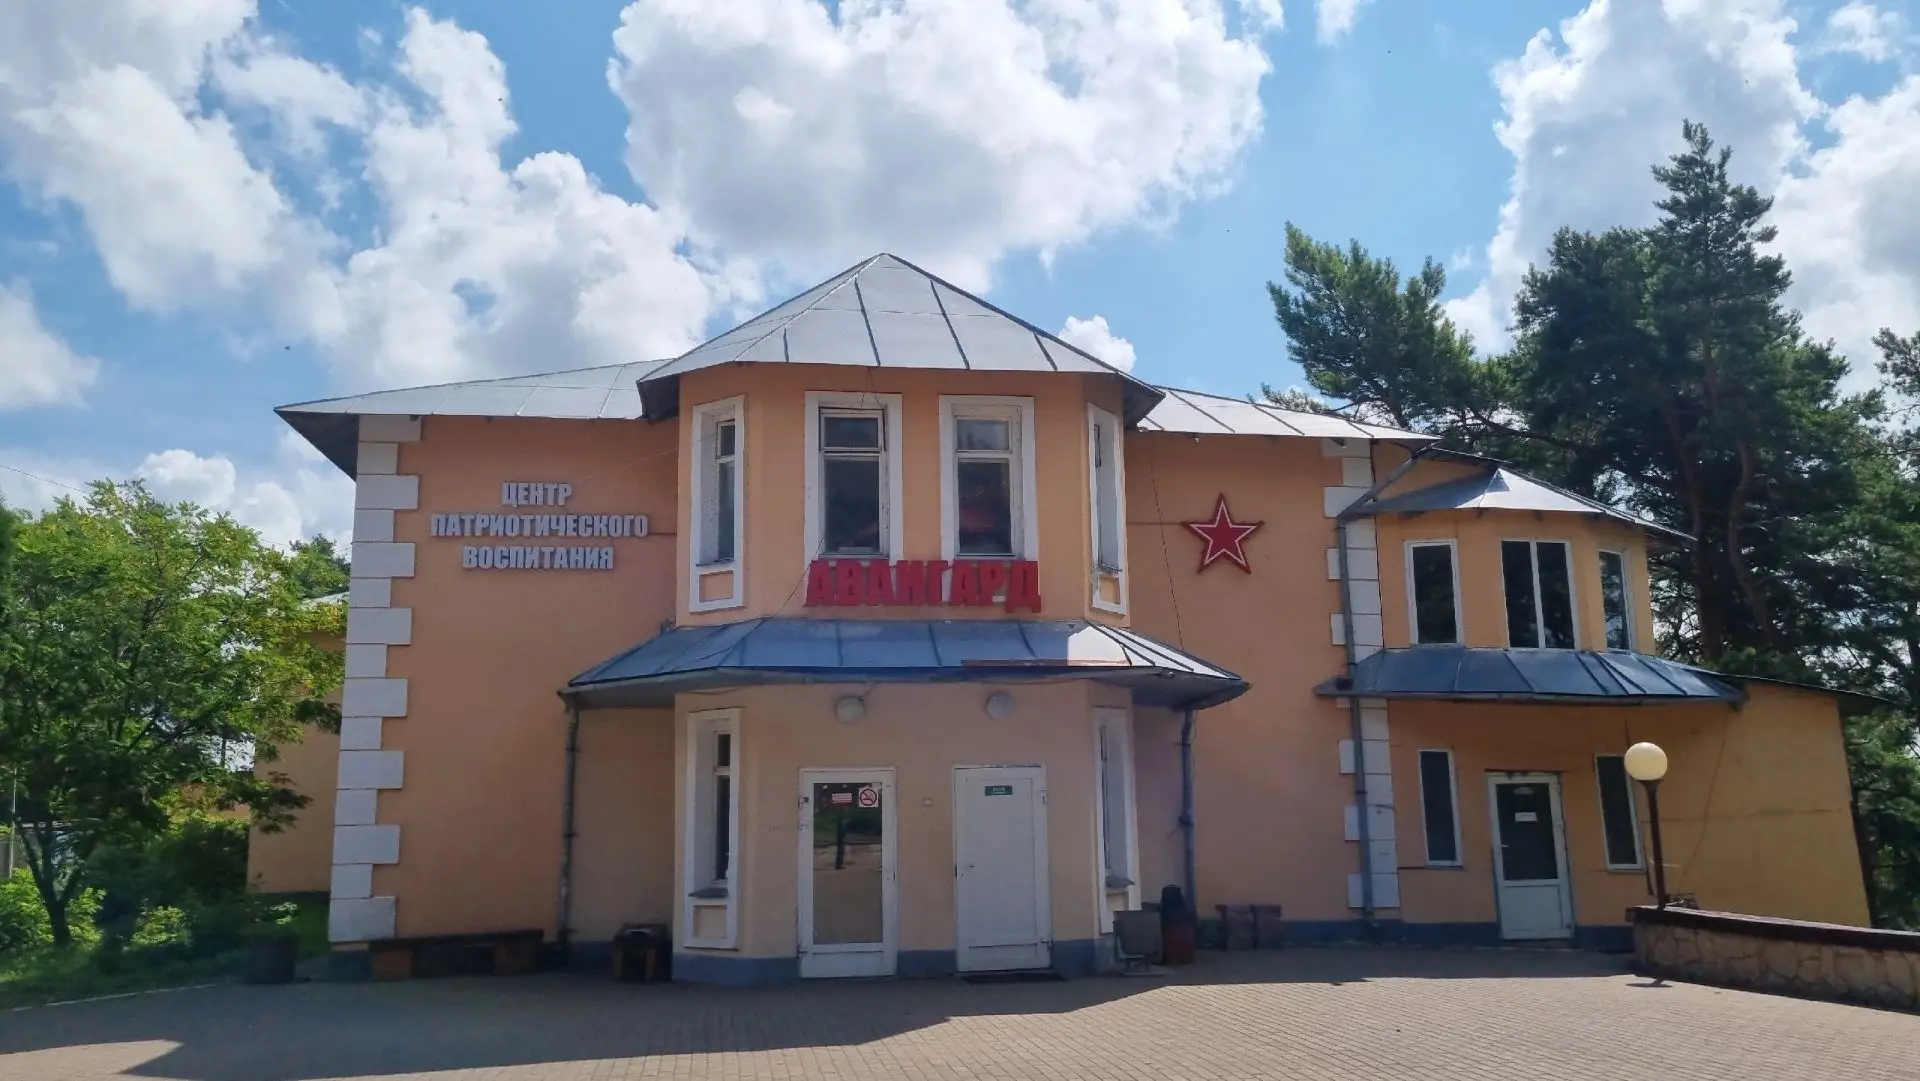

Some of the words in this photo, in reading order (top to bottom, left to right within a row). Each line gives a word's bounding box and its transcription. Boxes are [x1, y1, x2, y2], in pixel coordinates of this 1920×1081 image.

[501, 482, 573, 508] ЦЕНТР
[430, 513, 649, 538] ПАТРИОТИЧЕСКОГО
[462, 545, 614, 570] ВОСПИТАНИЯ
[804, 559, 1042, 613] АВАНГАРД
